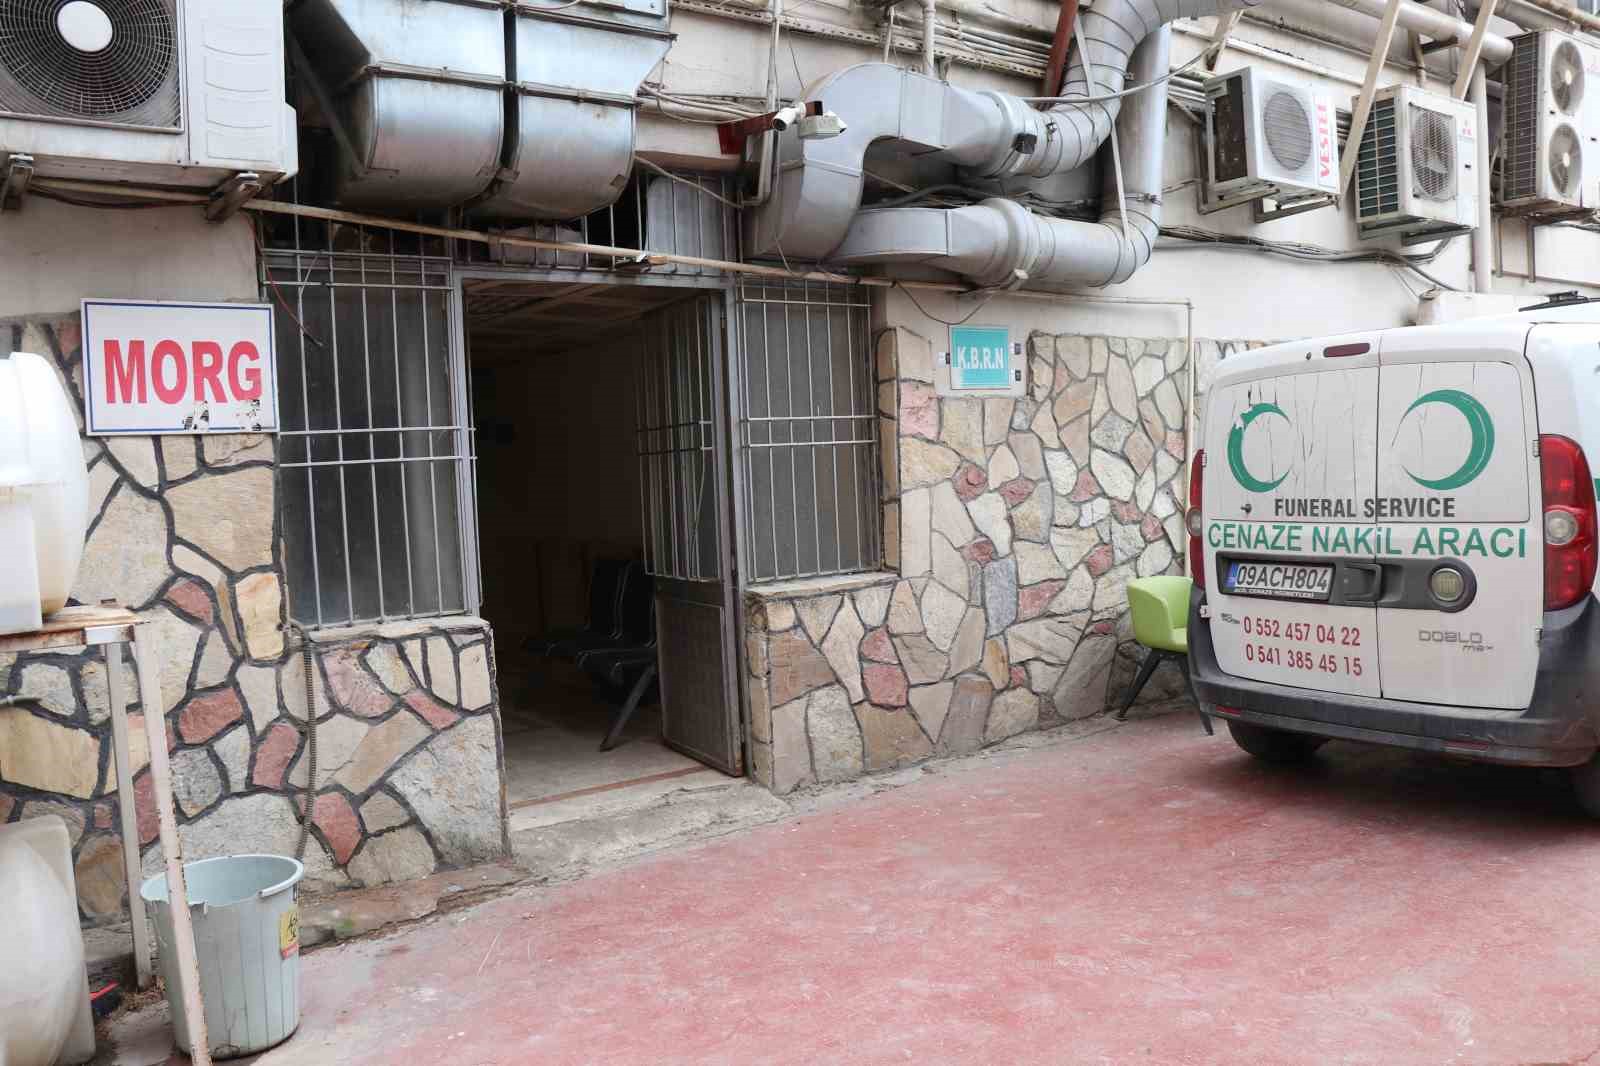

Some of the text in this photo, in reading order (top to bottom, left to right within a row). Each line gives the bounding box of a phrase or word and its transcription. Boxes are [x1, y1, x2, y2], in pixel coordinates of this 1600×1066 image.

[103, 338, 263, 405] MORG
[1274, 497, 1456, 518] FUNERAL SERVICE
[1208, 523, 1303, 551] CENAZE
[1411, 527, 1526, 558] ARACI
[1236, 566, 1329, 591] 09ACH804
[1243, 616, 1252, 635] 0
[1255, 617, 1280, 638] 552
[1285, 622, 1311, 641] 457
[1316, 624, 1336, 645] 04
[1341, 626, 1361, 647] 22
[1419, 630, 1482, 644] DOBLO
[1246, 644, 1363, 677] 0 541 385 45 15
